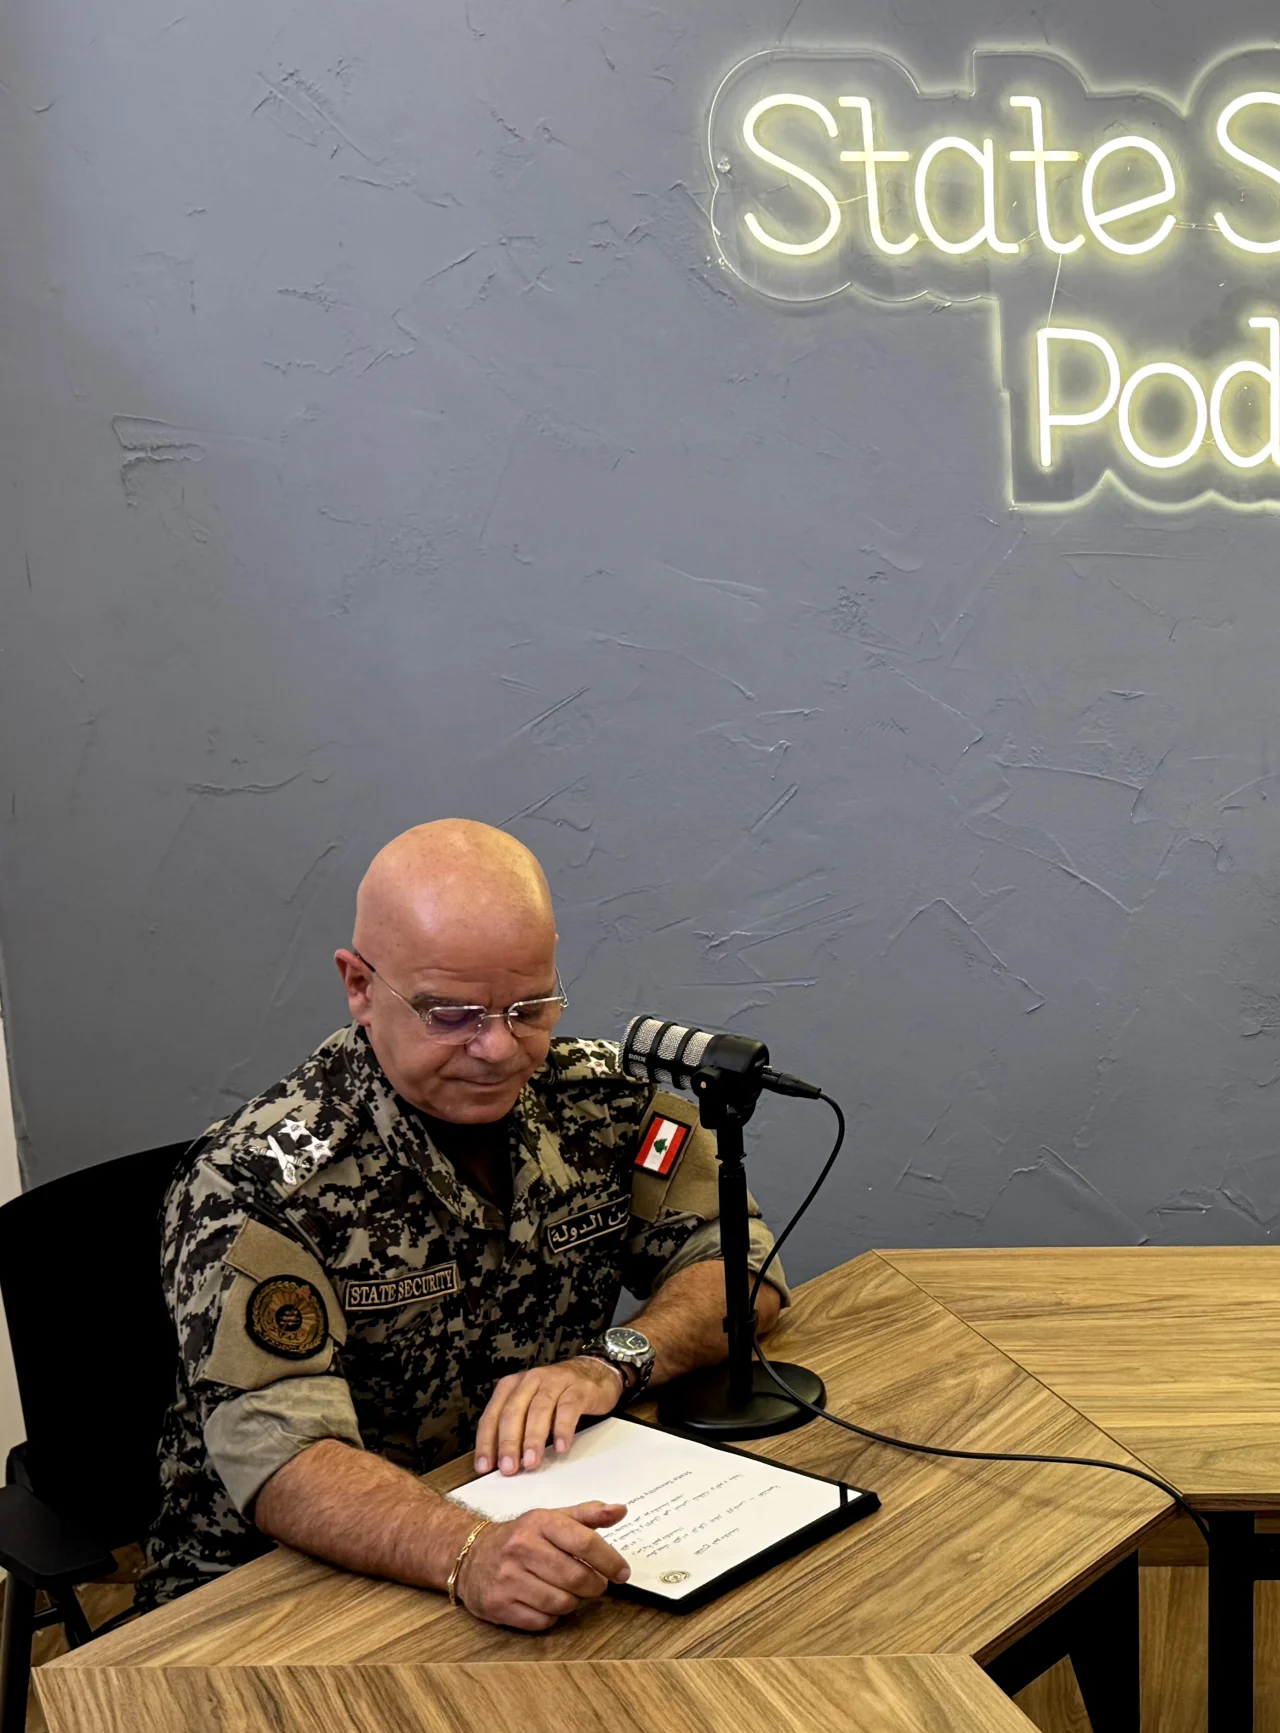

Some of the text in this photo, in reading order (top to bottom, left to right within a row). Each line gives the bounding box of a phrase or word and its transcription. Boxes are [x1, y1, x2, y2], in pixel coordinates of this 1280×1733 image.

[740, 92, 1178, 257] State
[550, 1212, 603, 1243] الدولة
[350, 1269, 453, 1304] STATE SECURITY
